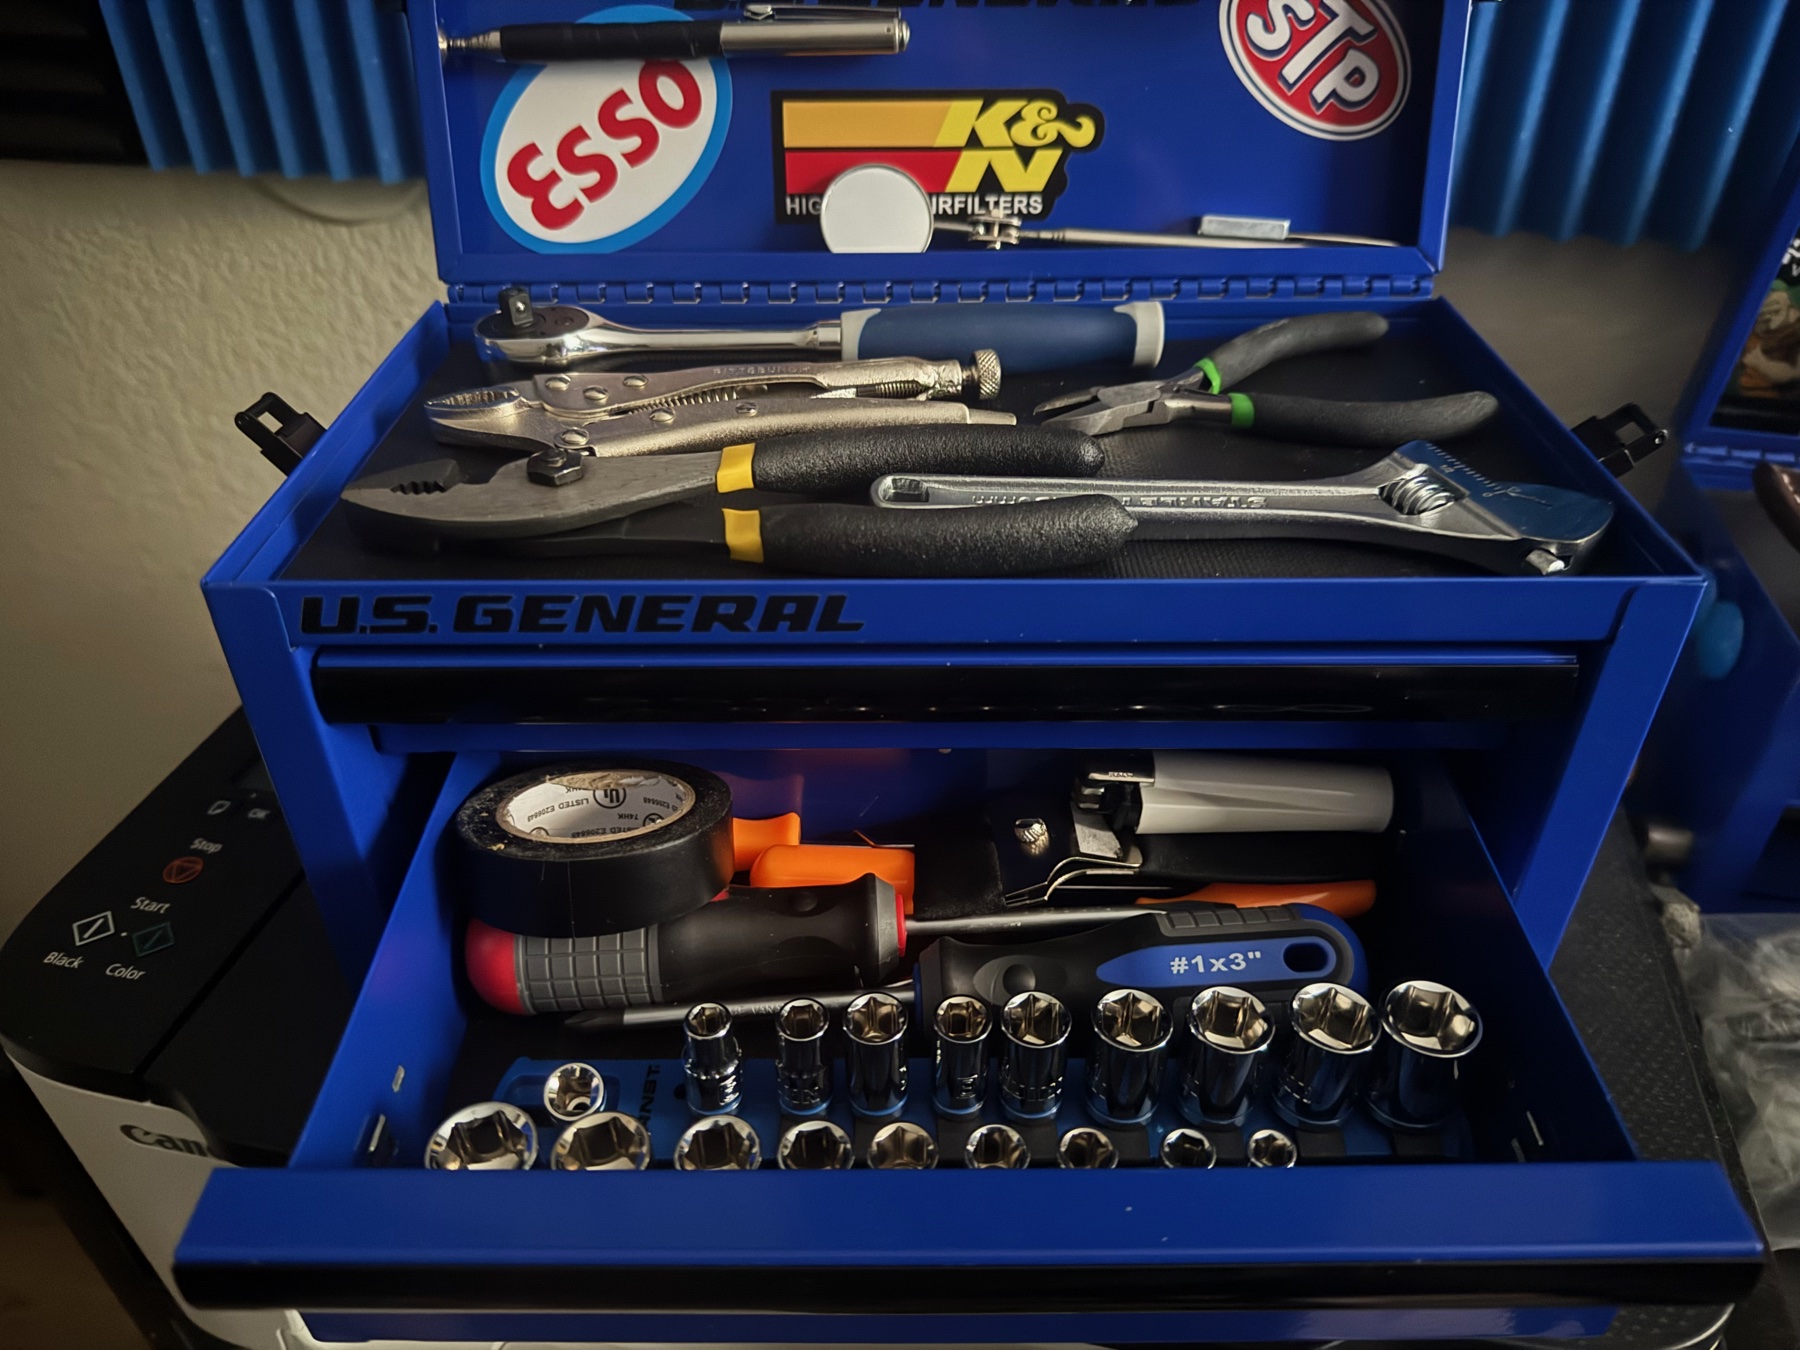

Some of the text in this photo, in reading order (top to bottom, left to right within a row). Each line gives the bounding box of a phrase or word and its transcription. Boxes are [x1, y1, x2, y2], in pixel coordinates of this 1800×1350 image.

[1245, 0, 1381, 106] STP
[785, 195, 822, 215] HIG
[301, 594, 865, 634] U.S. GENERAL
[558, 797, 589, 810] LISTED
[617, 812, 639, 821] 74HK
[189, 837, 224, 855] Stop
[130, 896, 171, 914] Start
[42, 951, 85, 969] Black
[1169, 950, 1262, 976] #1x3"
[104, 963, 147, 981] Color
